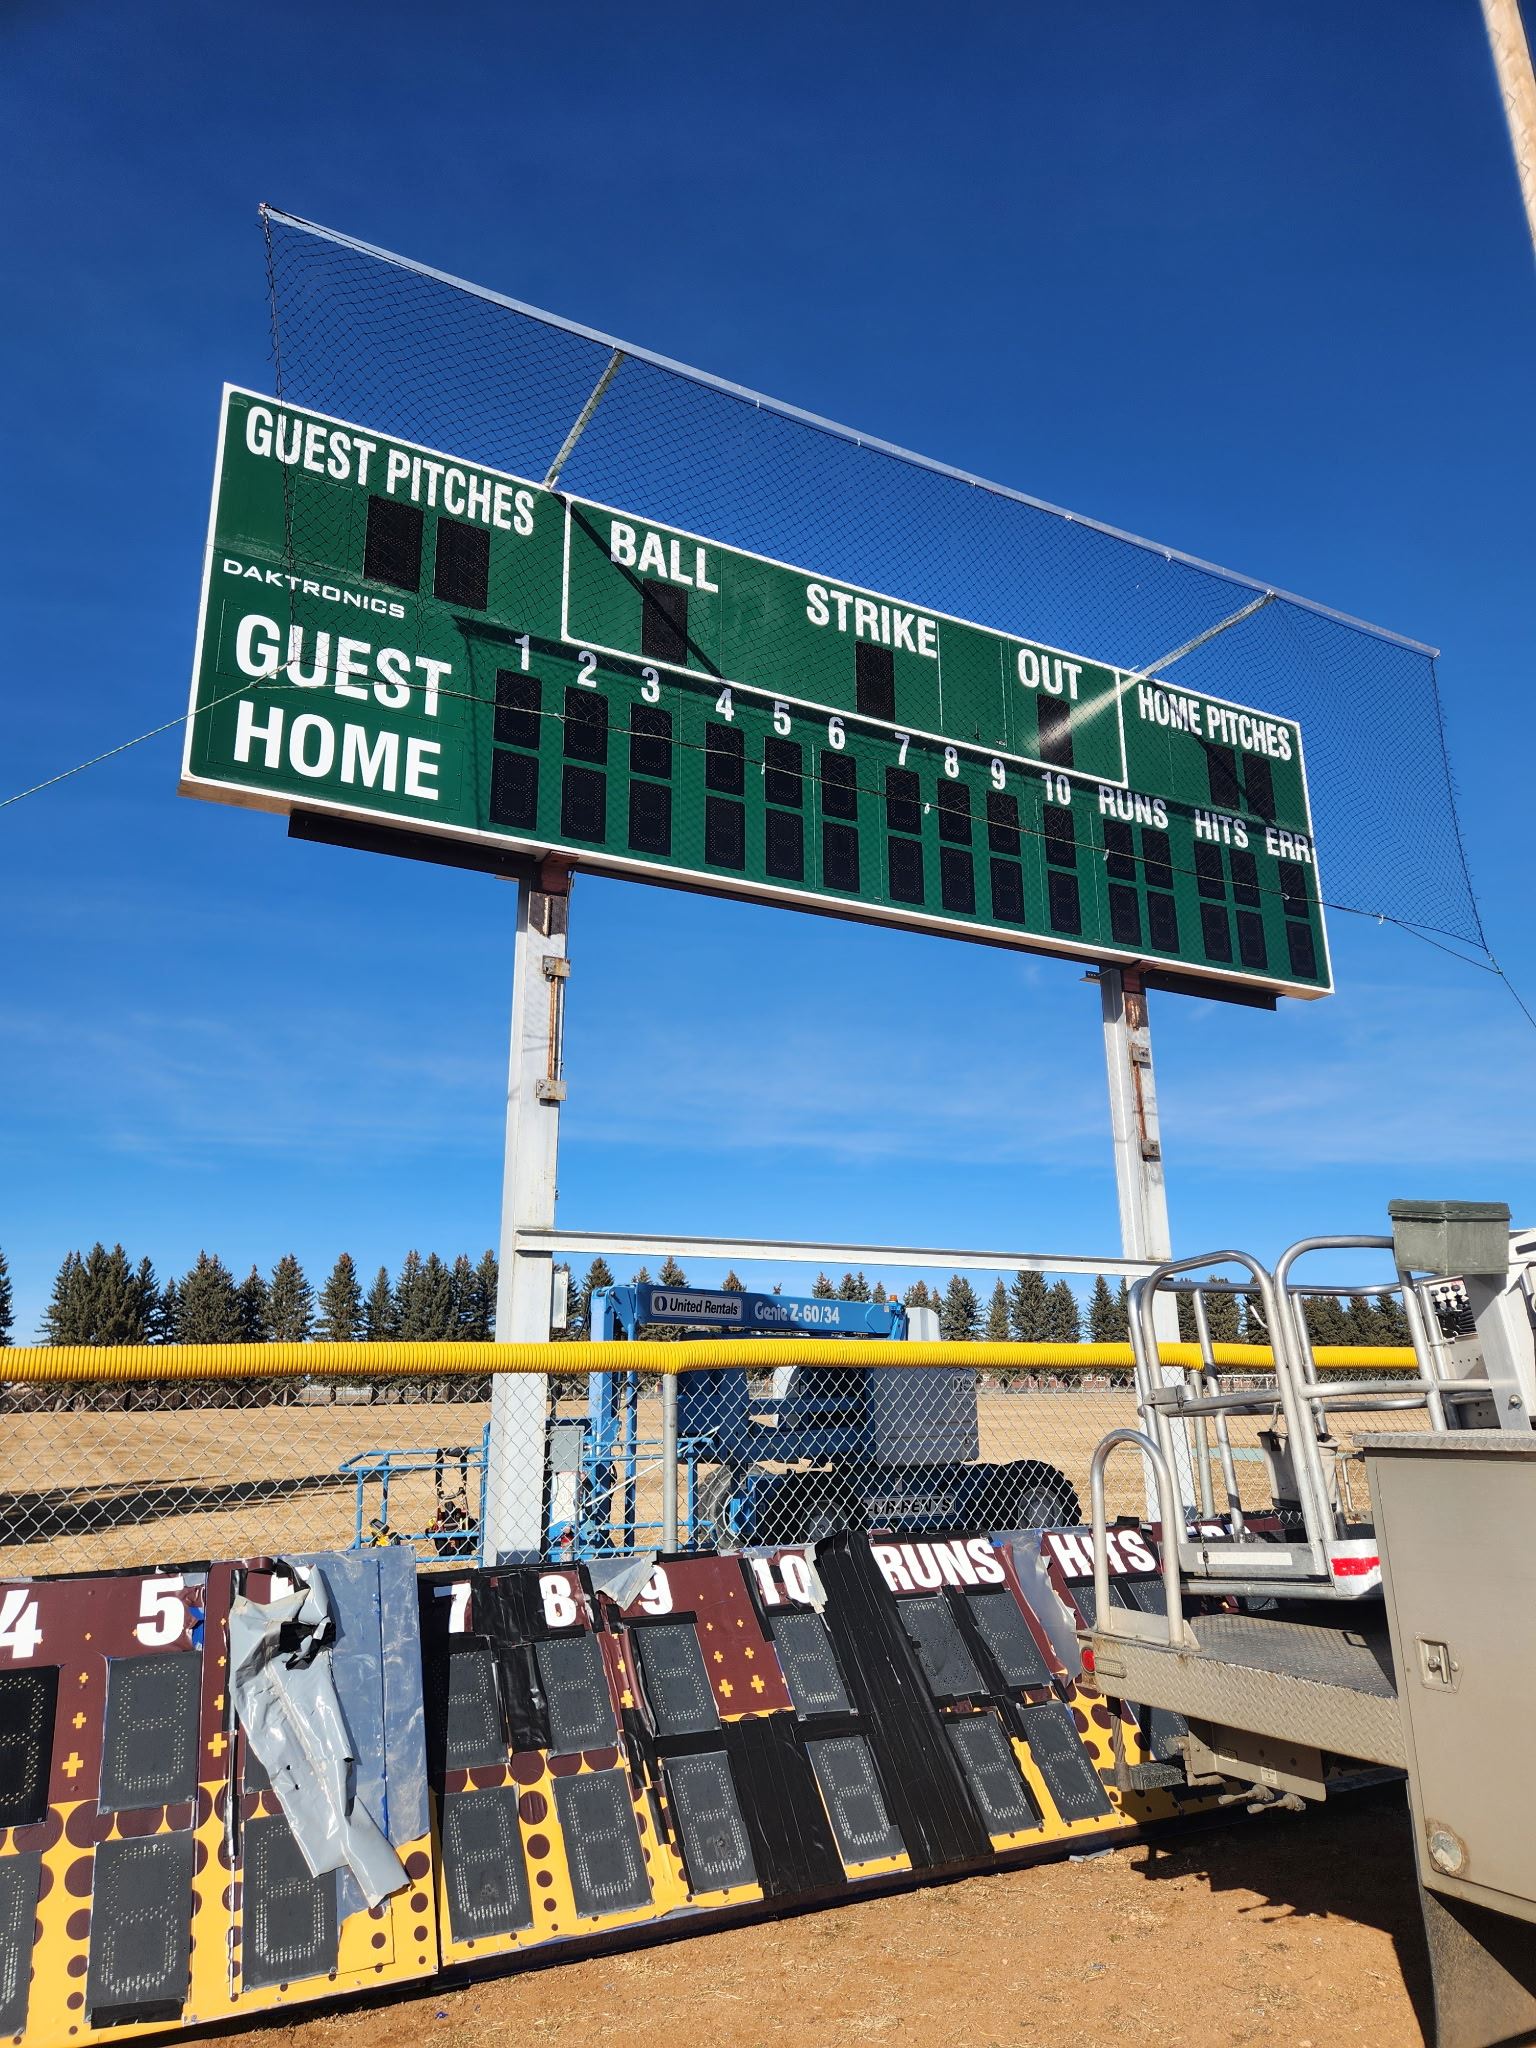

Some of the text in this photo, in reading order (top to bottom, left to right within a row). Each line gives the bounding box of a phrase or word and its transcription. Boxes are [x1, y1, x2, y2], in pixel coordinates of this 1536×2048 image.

[246, 406, 535, 536] GUEST PITCHES
[223, 558, 405, 619] DAKTRONICS
[611, 520, 719, 593] BALL
[806, 583, 937, 658] STRIKE
[236, 614, 452, 717] GUEST
[1017, 648, 1082, 700] OUT
[233, 699, 441, 801] HOME
[515, 635, 1313, 863] 1 2 3 4 5 6 7 8 9 10 RUNS HITS ERR
[1138, 684, 1293, 761] HOME PITCHES
[669, 1297, 739, 1316] United Rentals
[754, 1301, 841, 1324] Genie Z-60/34
[0, 1589, 43, 1659] 4
[136, 1576, 185, 1647] 5
[434, 1582, 471, 1633] 7
[538, 1574, 577, 1628] 8
[640, 1564, 673, 1615] 9
[752, 1554, 813, 1605] 10
[871, 1538, 1006, 1592] RUNS
